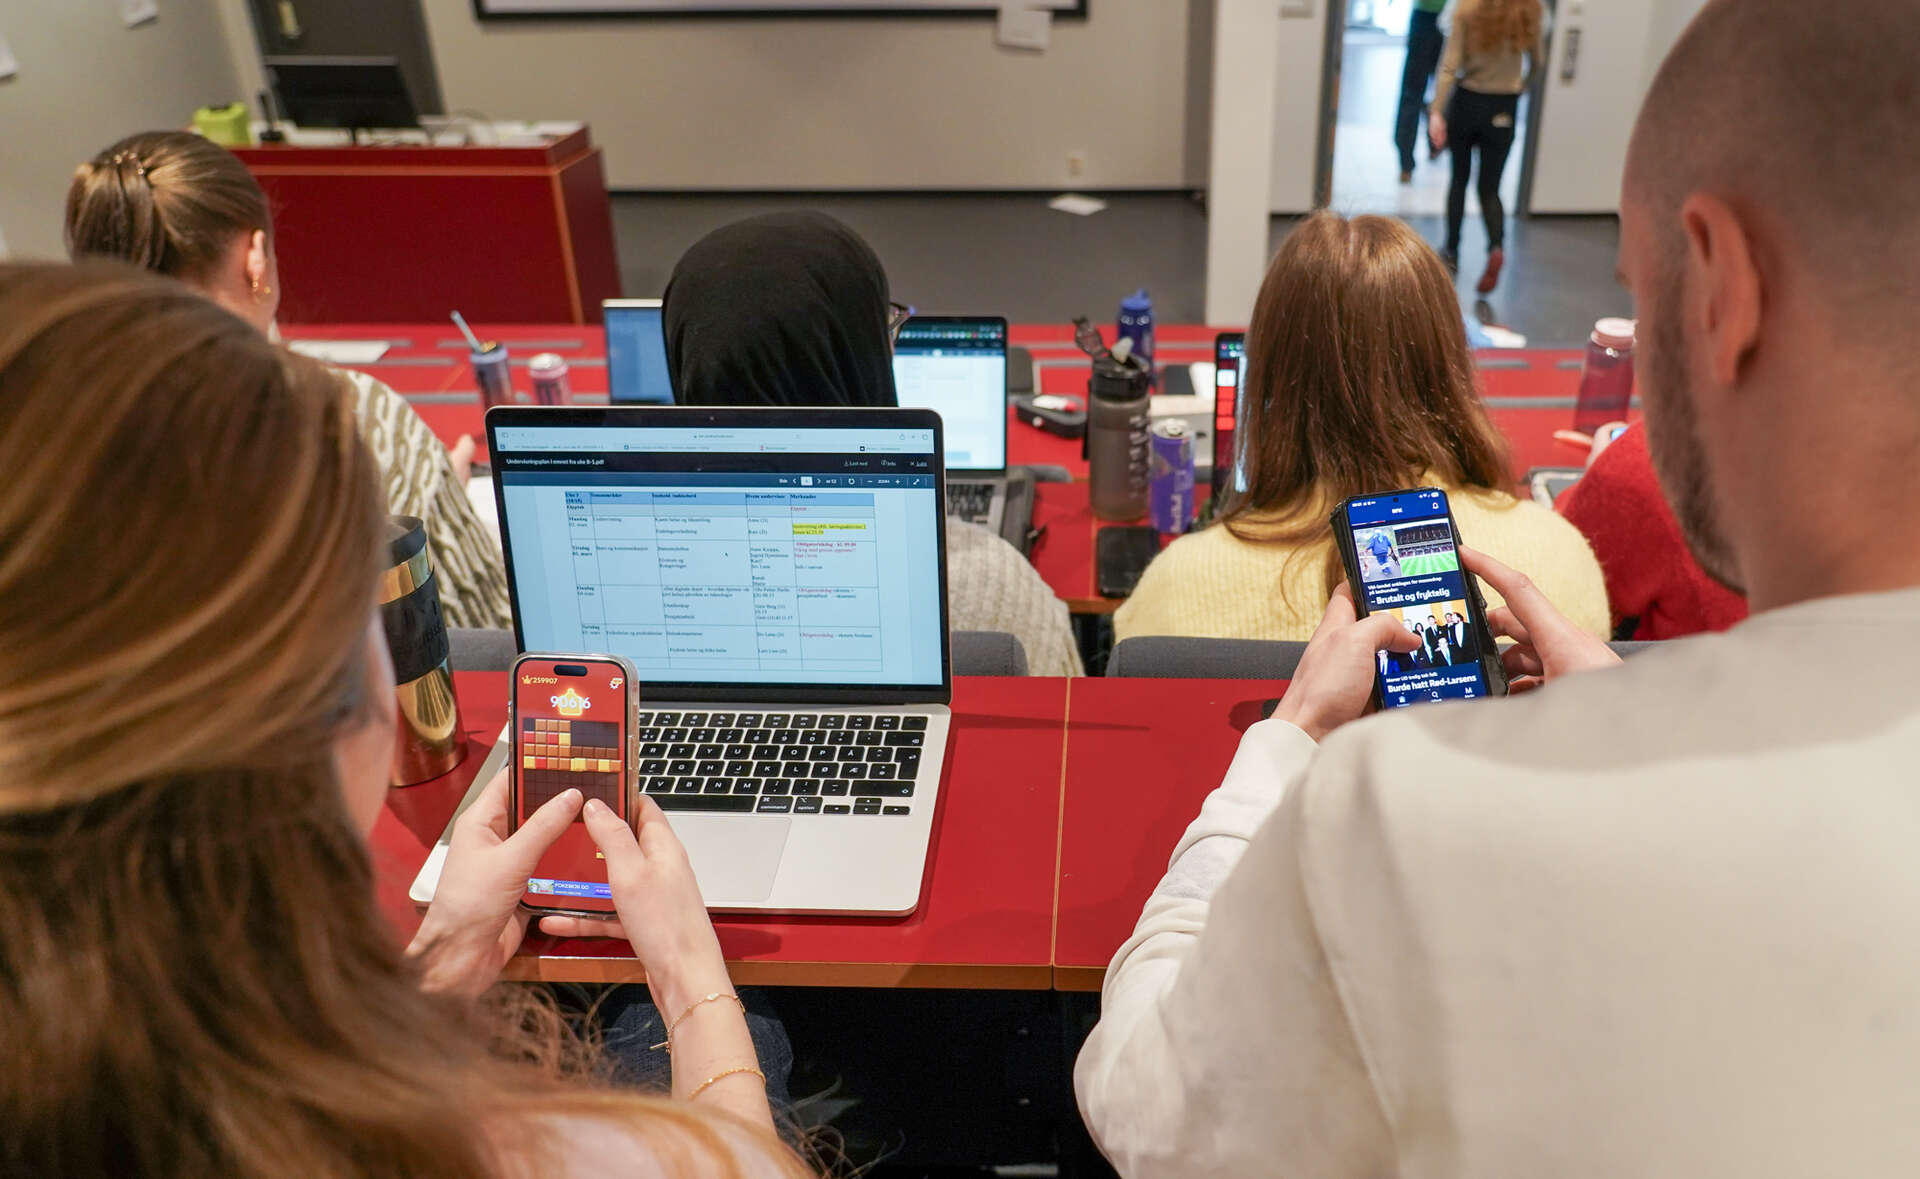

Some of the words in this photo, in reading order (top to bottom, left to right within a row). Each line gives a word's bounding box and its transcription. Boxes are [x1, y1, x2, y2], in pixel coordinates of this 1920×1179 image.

[1376, 594, 1404, 604] Brutalt
[1405, 593, 1415, 602] og
[1416, 588, 1450, 599] fryktelig
[532, 676, 558, 685] 259907
[1387, 683, 1411, 693] Burde
[1411, 680, 1428, 689] hatt
[1429, 675, 1477, 687] Rød-Larsens
